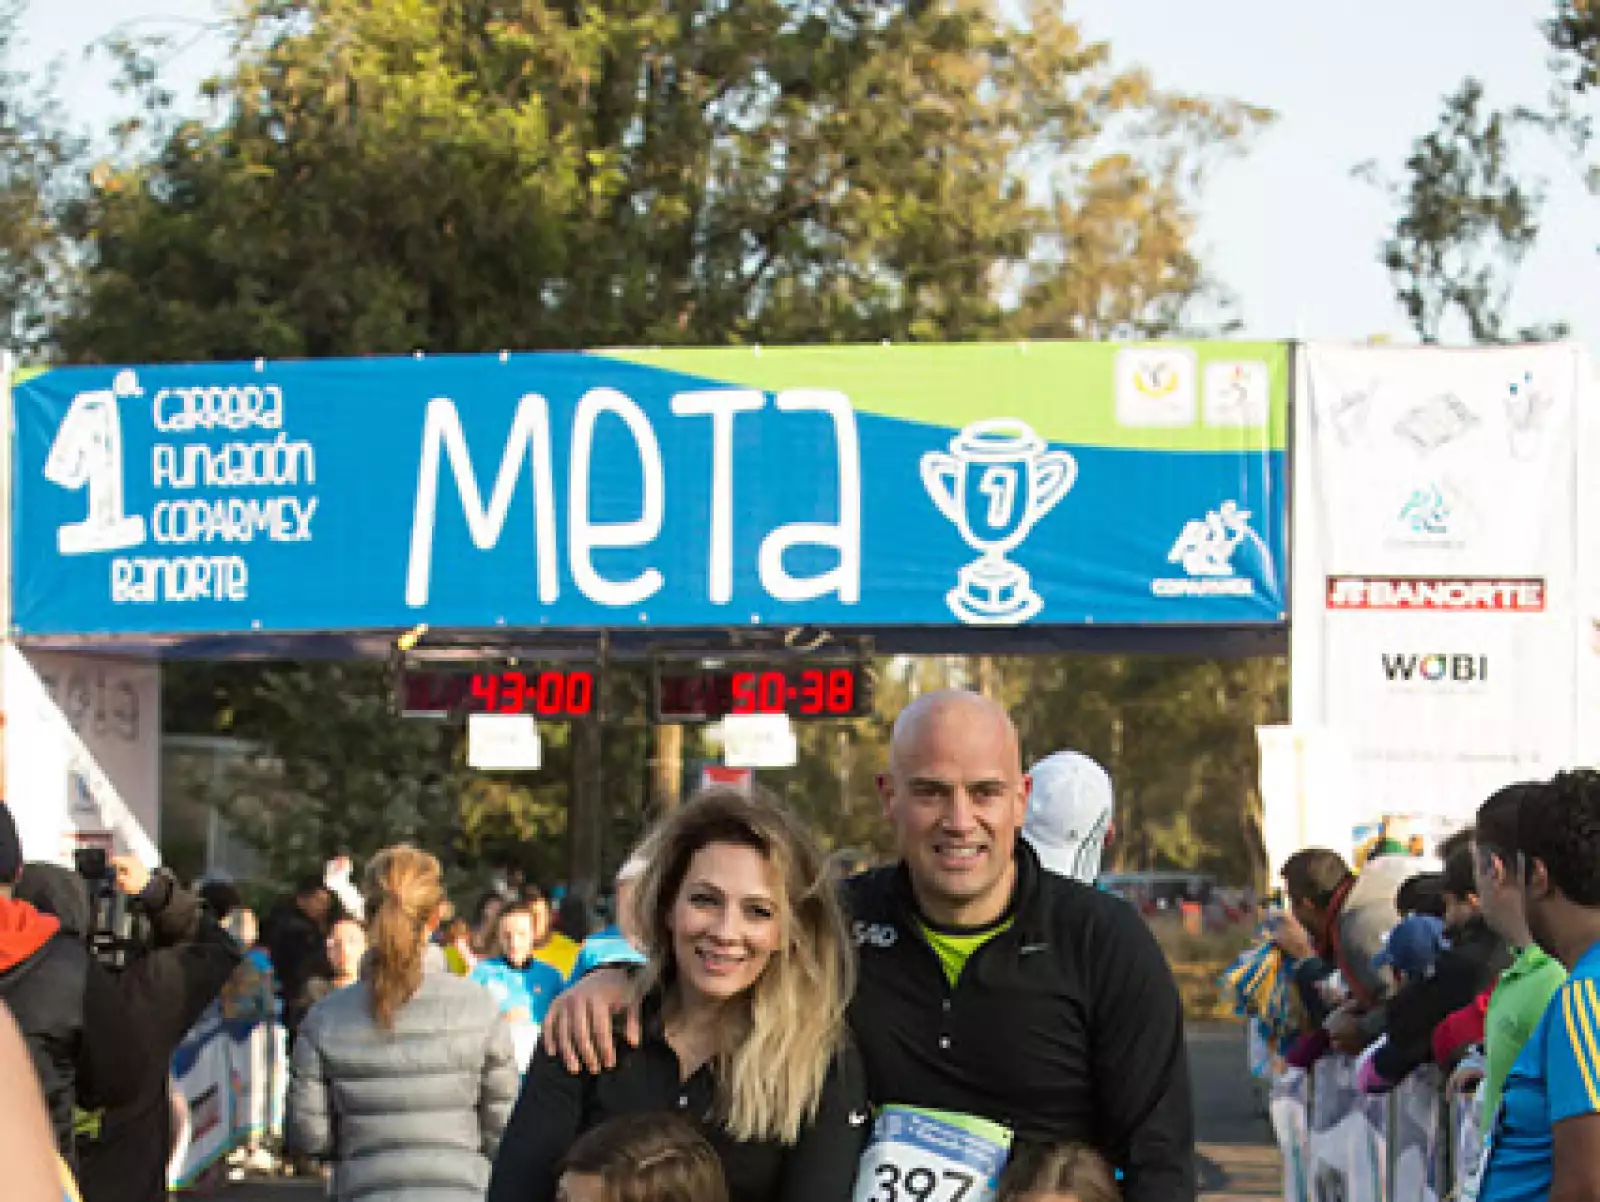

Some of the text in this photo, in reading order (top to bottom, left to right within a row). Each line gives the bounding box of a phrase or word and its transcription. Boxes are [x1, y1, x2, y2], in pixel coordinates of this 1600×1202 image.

[1382, 653, 1488, 682] WOBI
[470, 671, 593, 715] 43:00
[731, 669, 854, 715] 50:38
